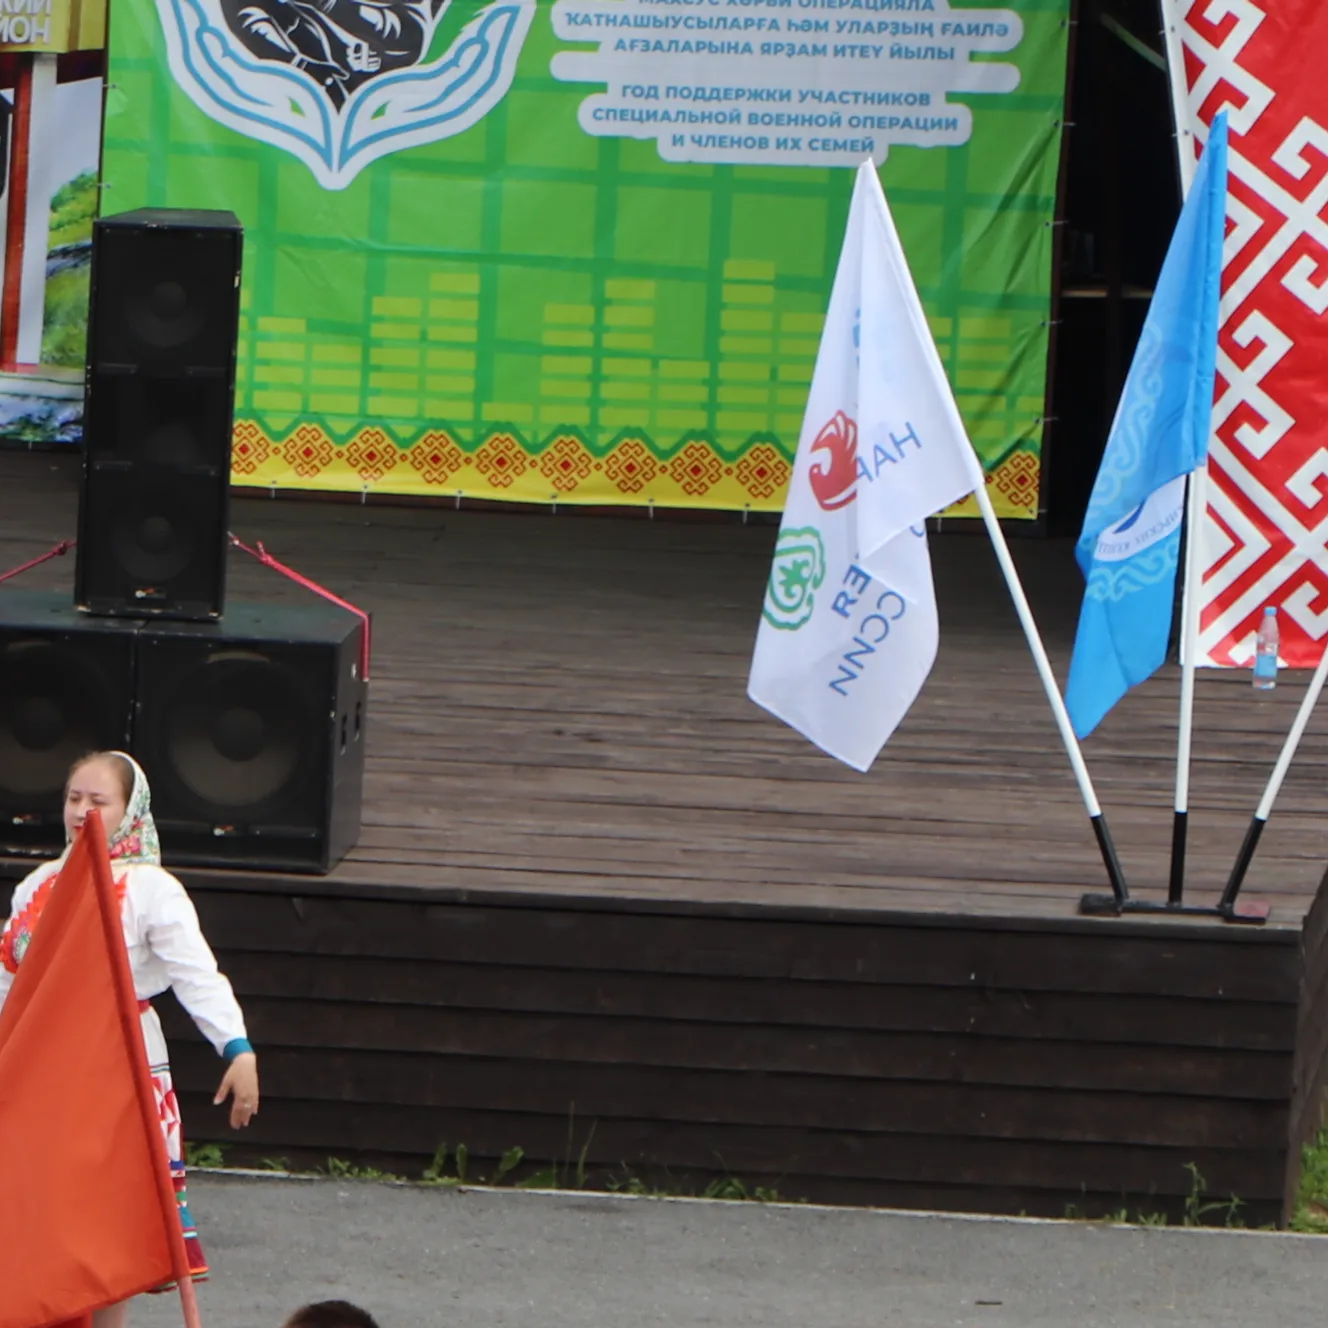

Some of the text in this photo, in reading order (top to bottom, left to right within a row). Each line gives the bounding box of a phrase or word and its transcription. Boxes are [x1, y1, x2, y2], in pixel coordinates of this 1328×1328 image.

[889, 44, 955, 61] ЙЫЛЫ
[621, 85, 932, 107] ГОД ПОДДЕРЖКИ УЧАСТНИКОВ
[591, 108, 959, 131] СПЕЦИАЛЬНОЙ ВОЕННОЙ ОПЕРАЦИИ
[672, 134, 875, 153] И ЧЛЕНОВ ИХ СЕМЕЙ
